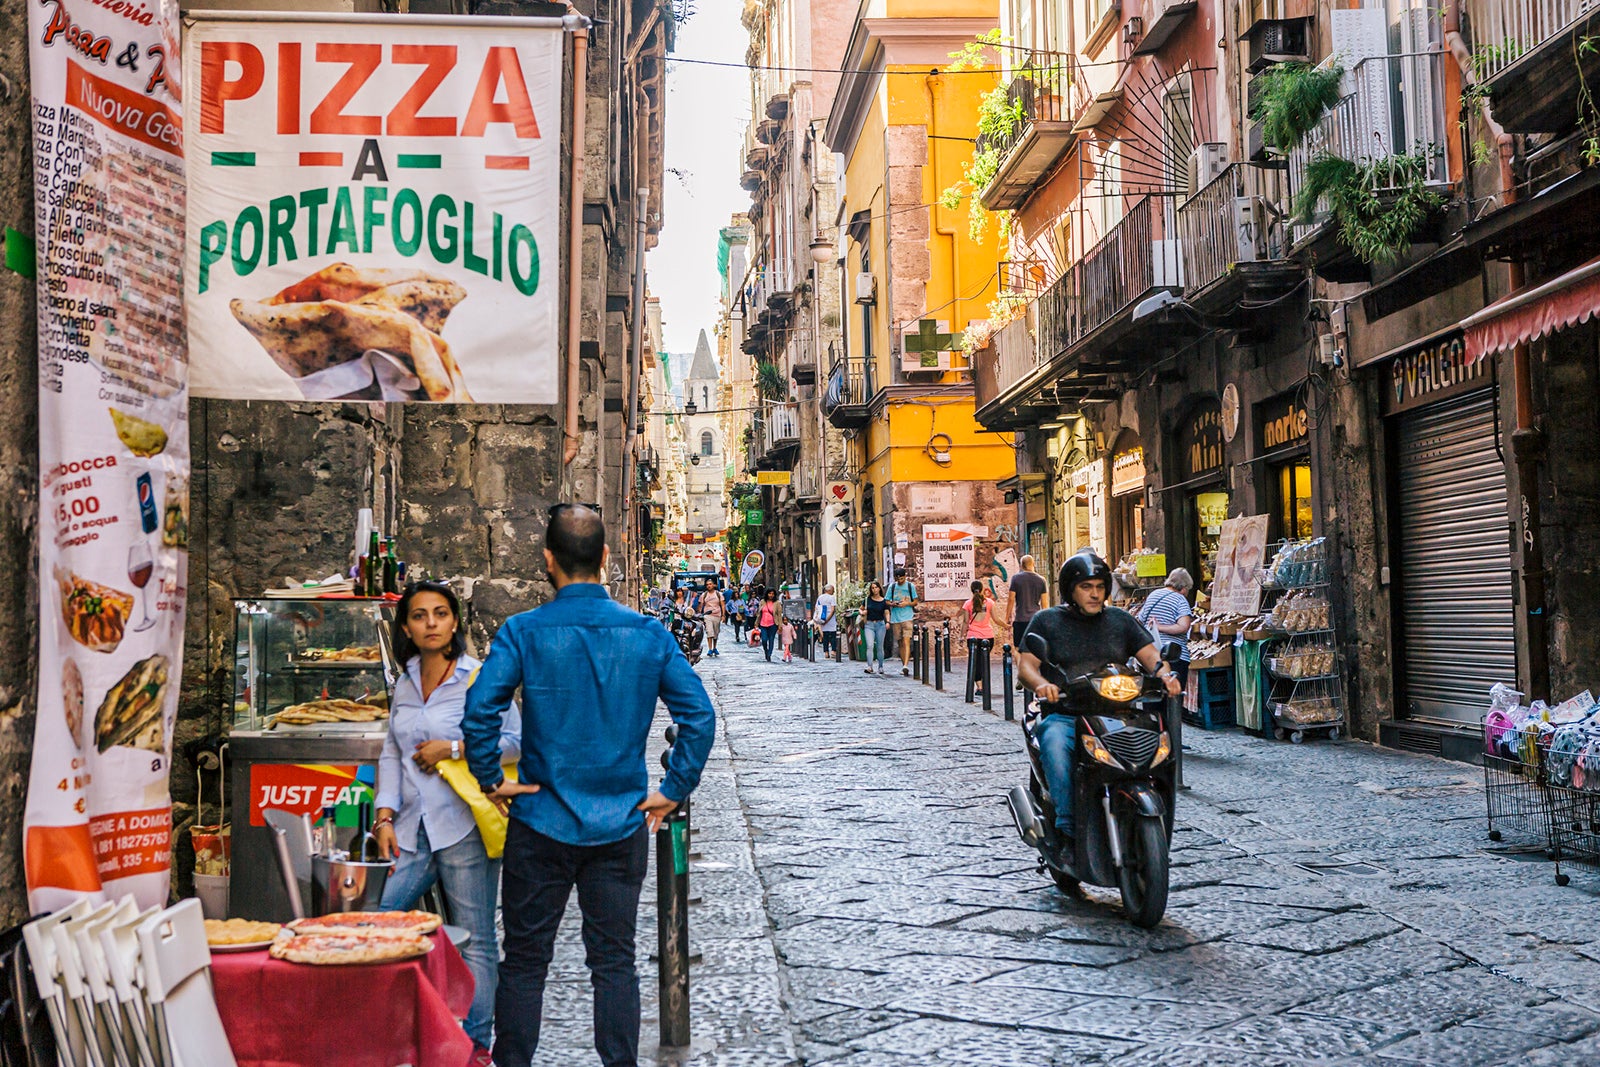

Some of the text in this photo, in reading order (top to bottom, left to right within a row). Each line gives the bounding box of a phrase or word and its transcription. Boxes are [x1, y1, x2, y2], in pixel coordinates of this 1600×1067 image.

[40, 0, 112, 63] Pizza
[81, 76, 144, 130] Nuova
[199, 41, 542, 139] PIZZA
[55, 140, 80, 159] Con
[351, 138, 389, 182] A
[54, 156, 82, 178] Chef
[48, 207, 72, 226] Alla
[49, 223, 85, 245] Filetto
[198, 186, 541, 298] PORTAFOGLIO
[48, 240, 104, 267] Prosciutto
[45, 256, 94, 282] Prosciutto
[258, 785, 367, 808] JUST EAT
[117, 817, 126, 832] A
